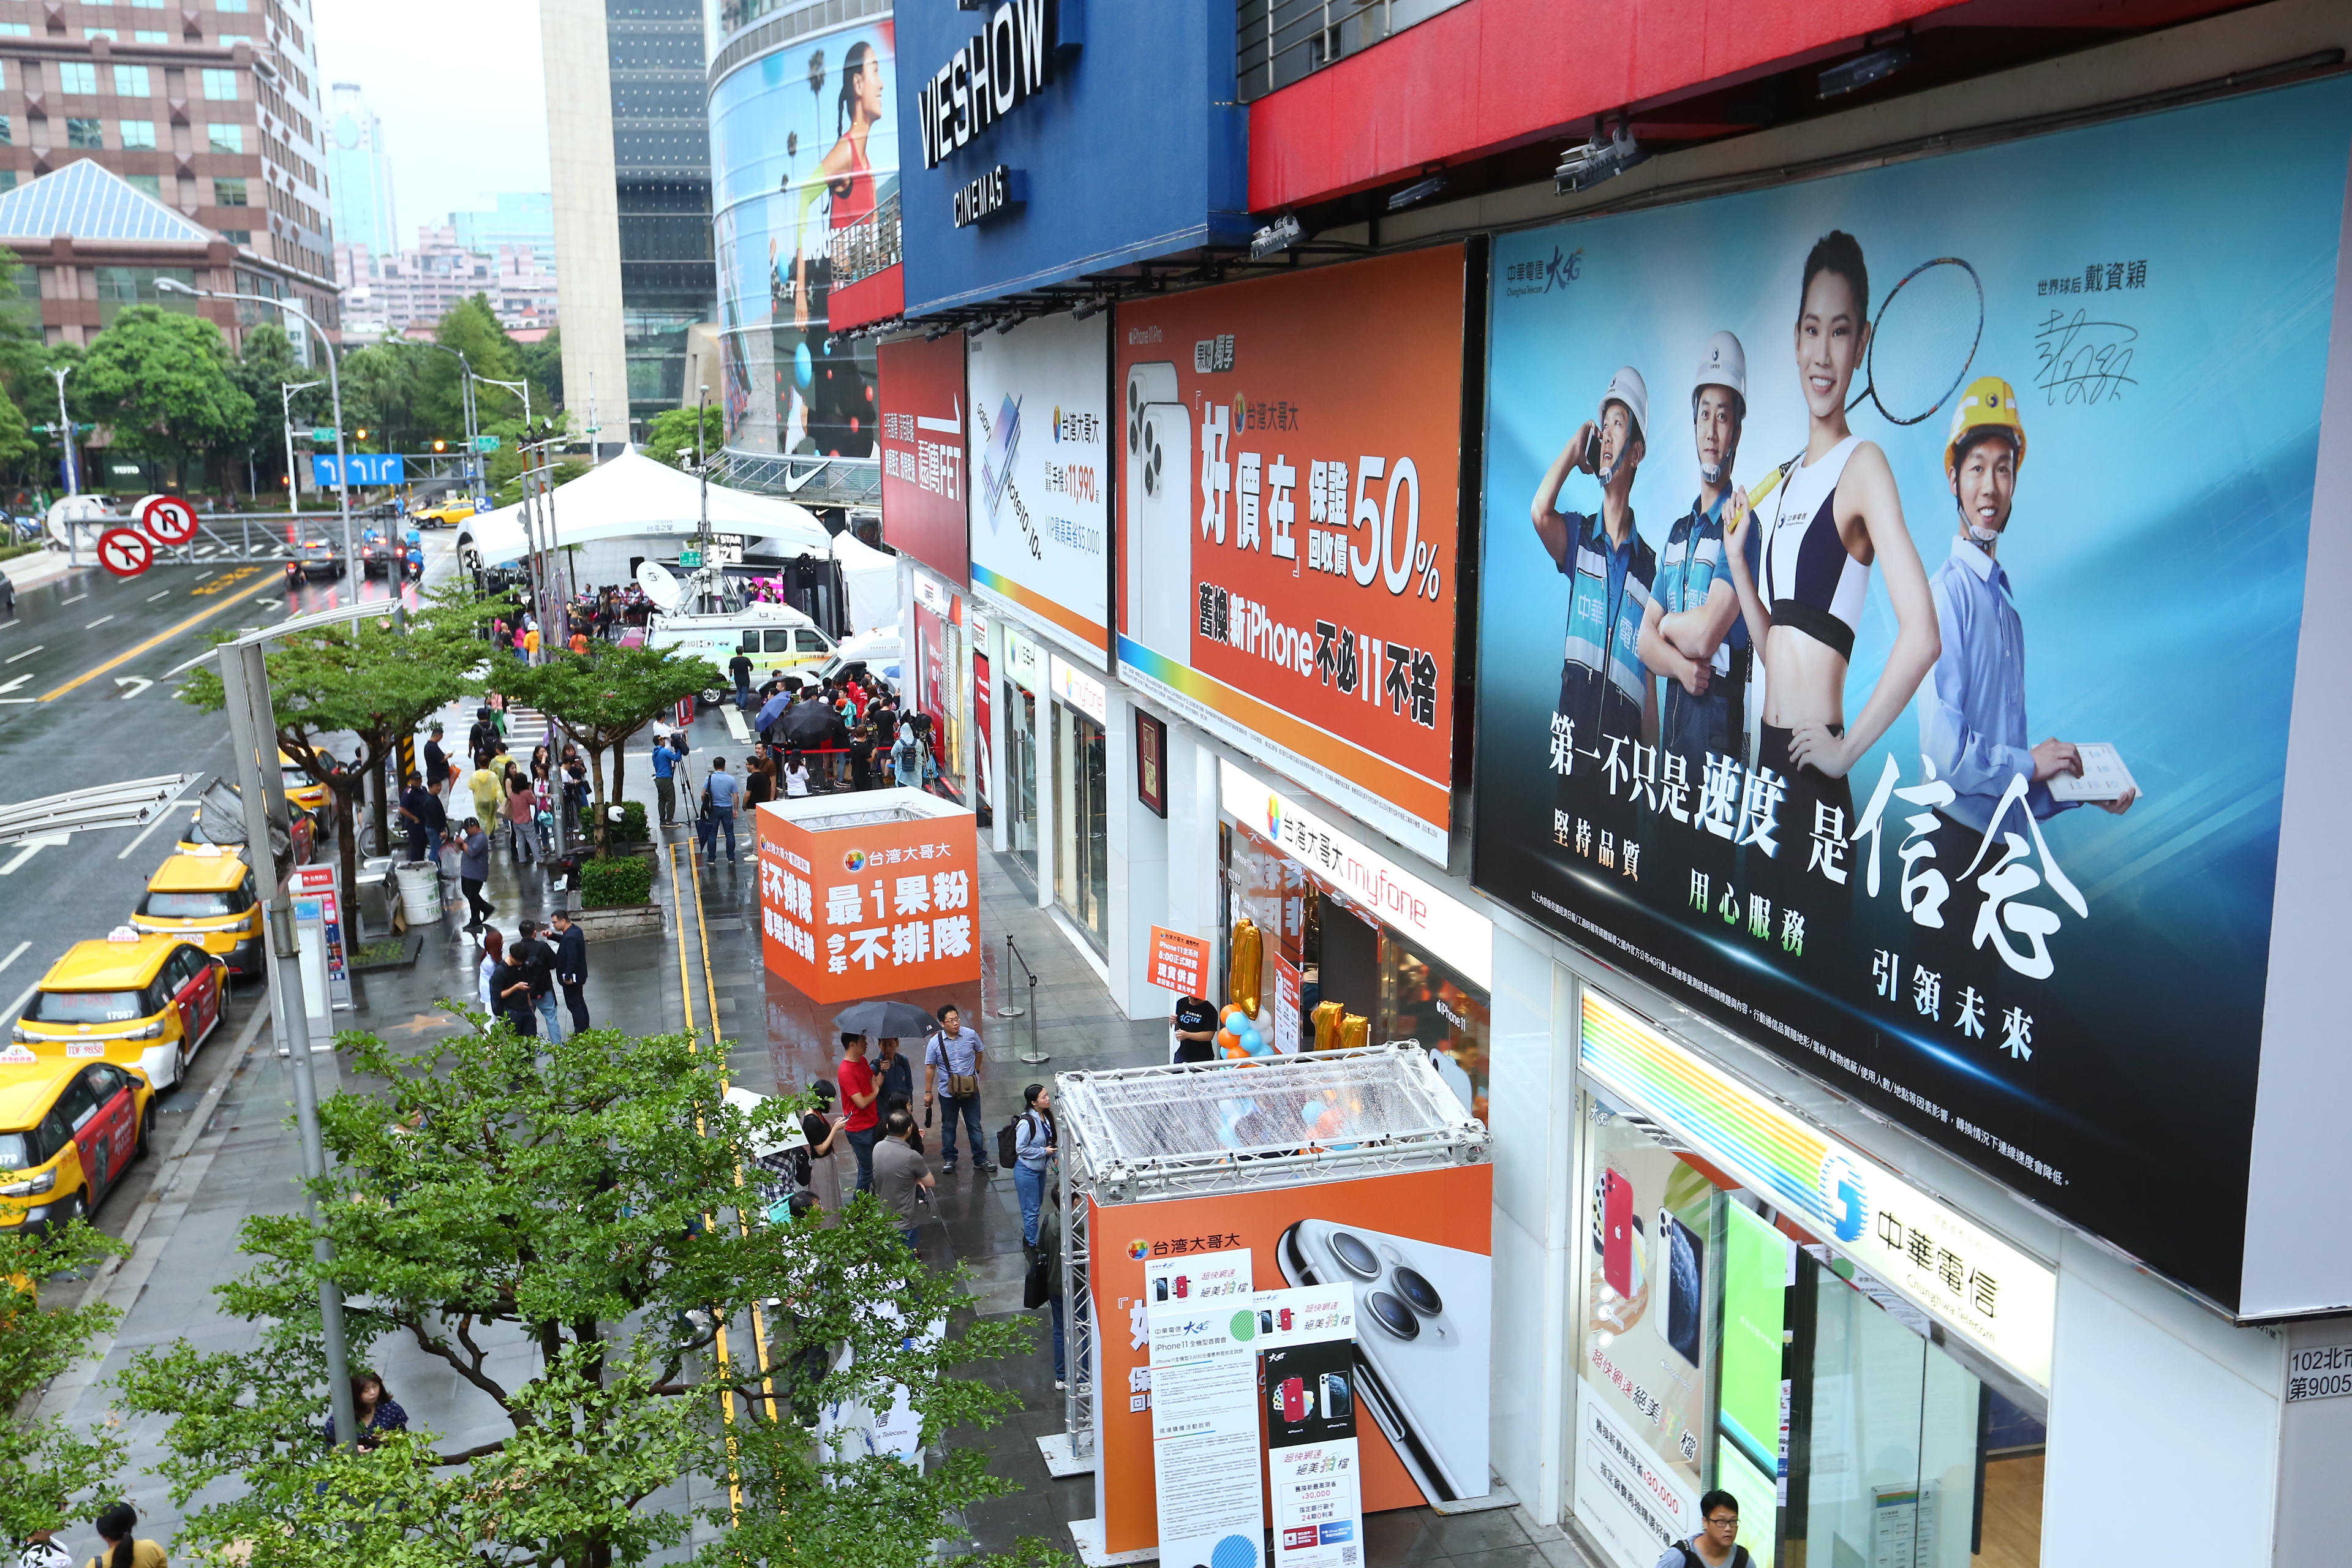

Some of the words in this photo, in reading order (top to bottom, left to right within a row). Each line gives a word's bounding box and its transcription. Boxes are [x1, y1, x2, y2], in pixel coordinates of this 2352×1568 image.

[918, 0, 1044, 170] VIESHOW
[954, 165, 1003, 229] CINEMAS
[1507, 260, 1544, 282] 中華電信
[2038, 277, 2081, 296] 世界球后
[2084, 260, 2147, 293] 戴資穎
[977, 402, 992, 443] Galaxy
[720, 535, 741, 545] STAR
[1349, 454, 1440, 600] 50%
[1548, 710, 1787, 858] 第一不只是速度
[1348, 858, 1427, 930] myfone
[1553, 808, 1641, 882] 堅持品質
[1689, 867, 1806, 957] 用心服務
[1872, 949, 2034, 1061] 引領未來
[1157, 962, 1197, 987] 現貨供應
[1878, 1210, 2000, 1319] 中華電信
[1155, 1326, 1182, 1335] 中華電信
[1155, 1342, 1180, 1352] iPhone
[1592, 1349, 1634, 1399] 超快網速
[2290, 1374, 2352, 1400] 第9005
